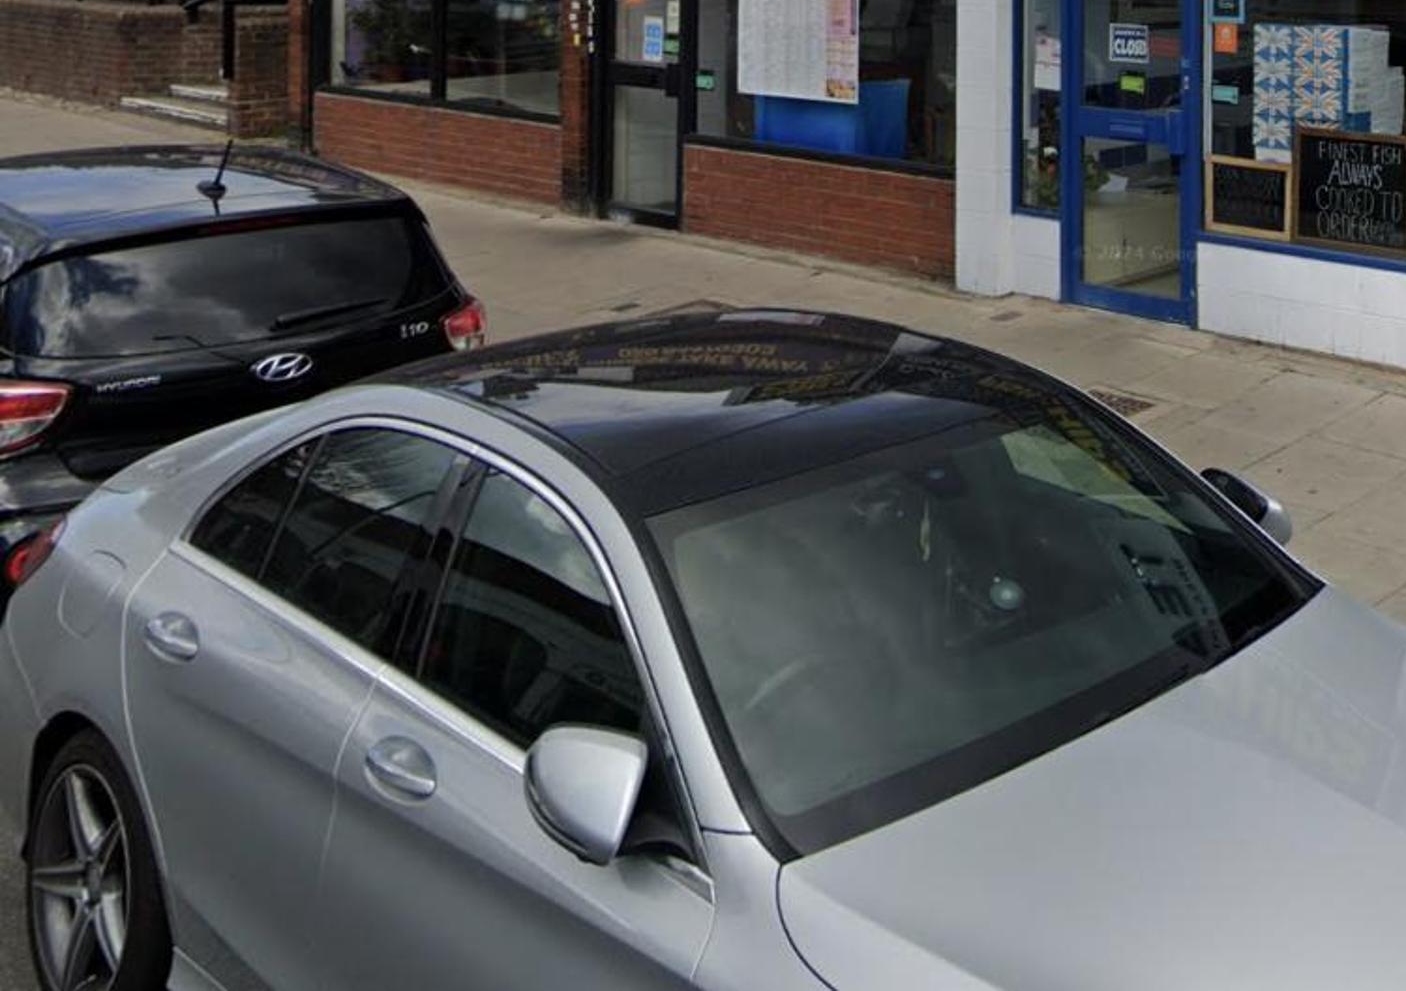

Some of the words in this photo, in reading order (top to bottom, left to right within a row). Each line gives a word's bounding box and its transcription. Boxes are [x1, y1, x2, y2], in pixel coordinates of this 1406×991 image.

[1319, 140, 1364, 163] FINEST
[1371, 145, 1401, 165] FISH
[1327, 160, 1383, 189] ALWAYS
[1379, 191, 1403, 223] TO
